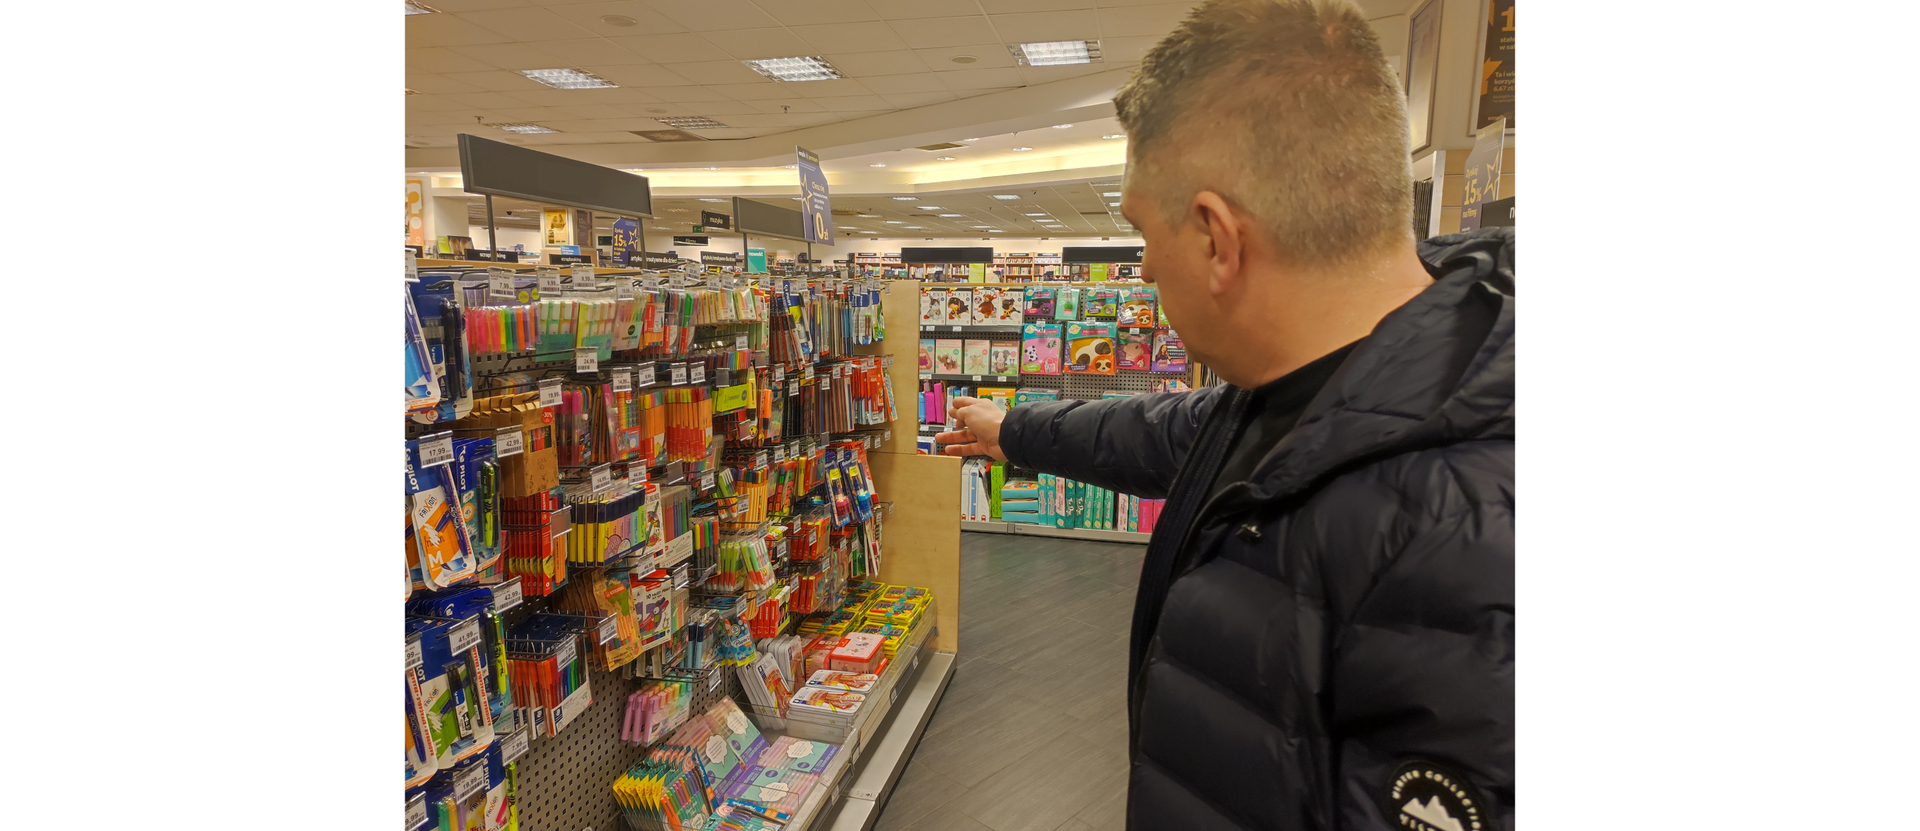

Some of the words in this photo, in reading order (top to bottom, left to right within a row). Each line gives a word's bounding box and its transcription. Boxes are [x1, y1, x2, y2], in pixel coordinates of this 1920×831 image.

[1466, 165, 1479, 178] Zyskaj
[1464, 178, 1481, 206] 15%
[1467, 207, 1477, 217] filmy
[614, 234, 627, 247] 15%
[407, 463, 420, 491] PILOT
[428, 550, 444, 568] M
[483, 766, 491, 790] PILOT
[1391, 769, 1420, 800] WINTER
[1424, 770, 1481, 831] COLLECTIO
